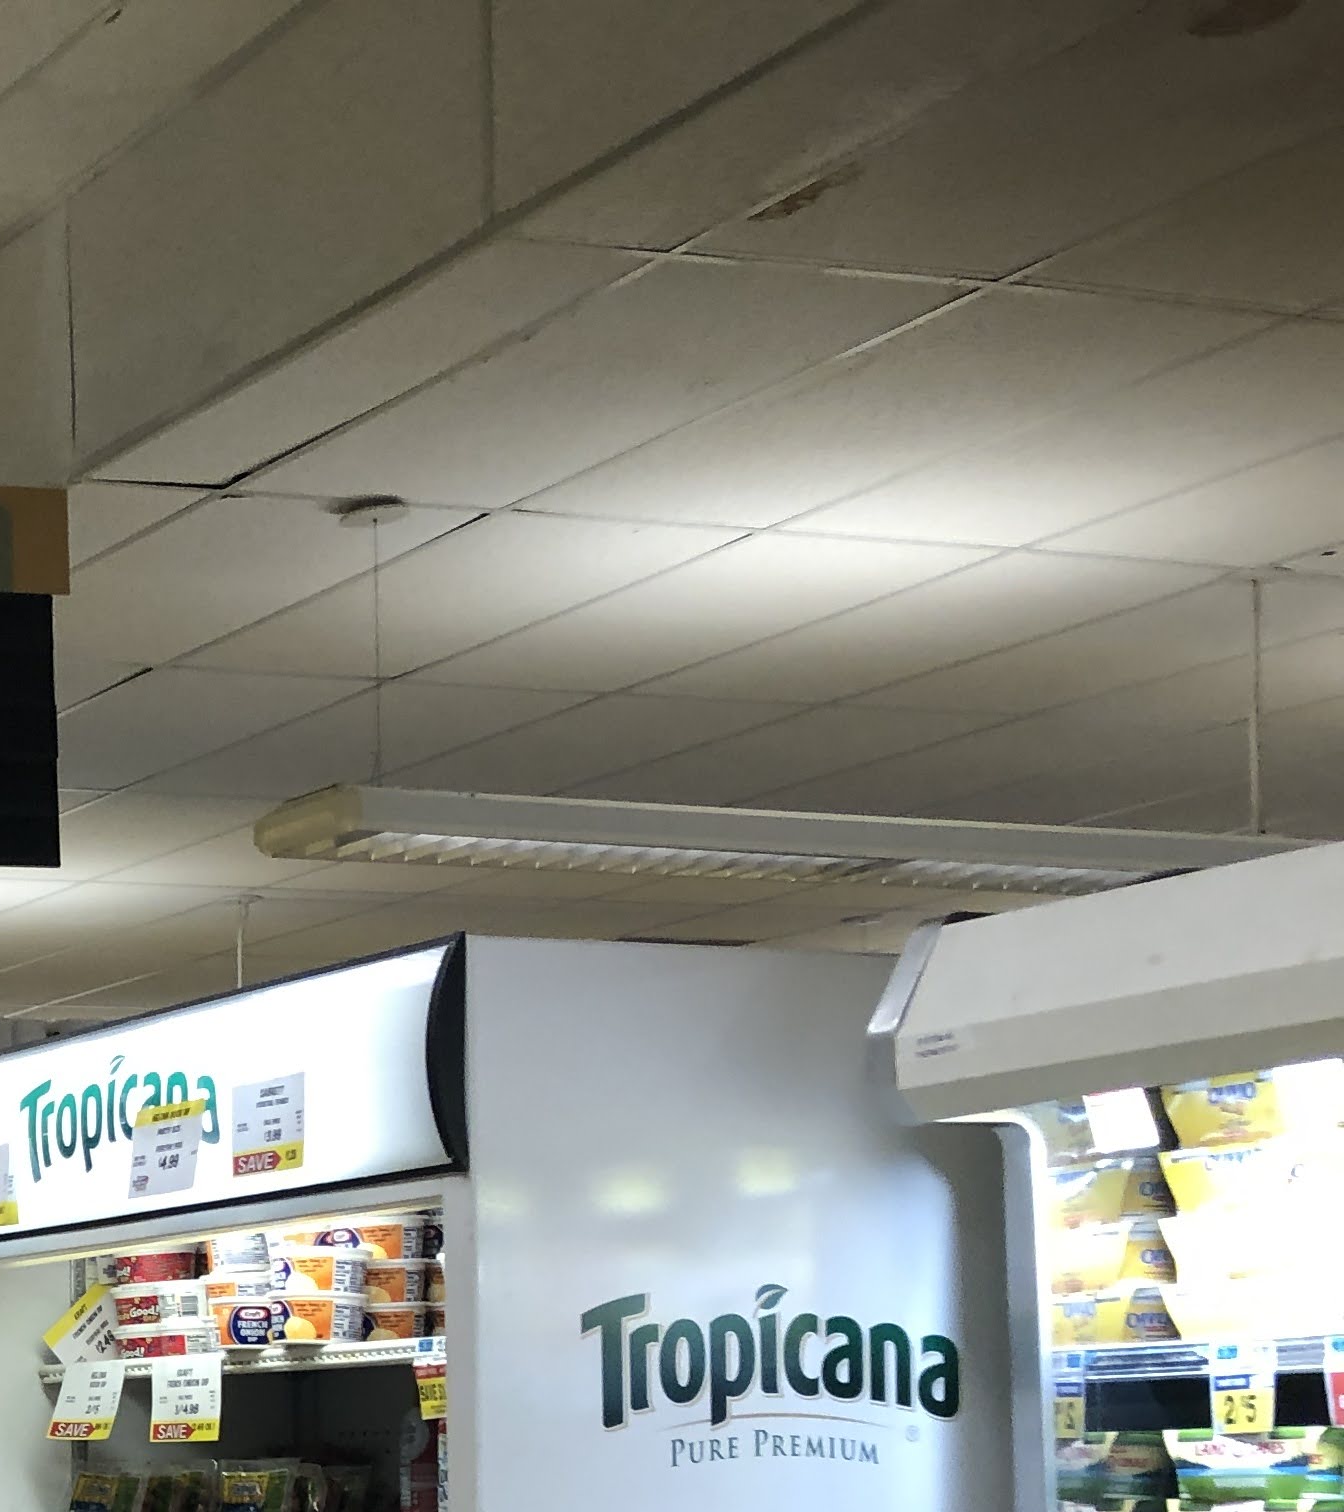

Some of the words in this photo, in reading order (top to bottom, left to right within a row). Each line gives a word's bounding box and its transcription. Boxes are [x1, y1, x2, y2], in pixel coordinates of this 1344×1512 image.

[237, 1153, 275, 1174] SAVE
[129, 1307, 159, 1319] Good!
[237, 1320, 268, 1330] FRENCH
[240, 1328, 266, 1337] ONION
[579, 1282, 961, 1432] Tropicana
[54, 1423, 91, 1437] SAVE
[157, 1425, 188, 1439] SAVE
[670, 1434, 739, 1467] PURE
[753, 1429, 880, 1465] PREMIUM
